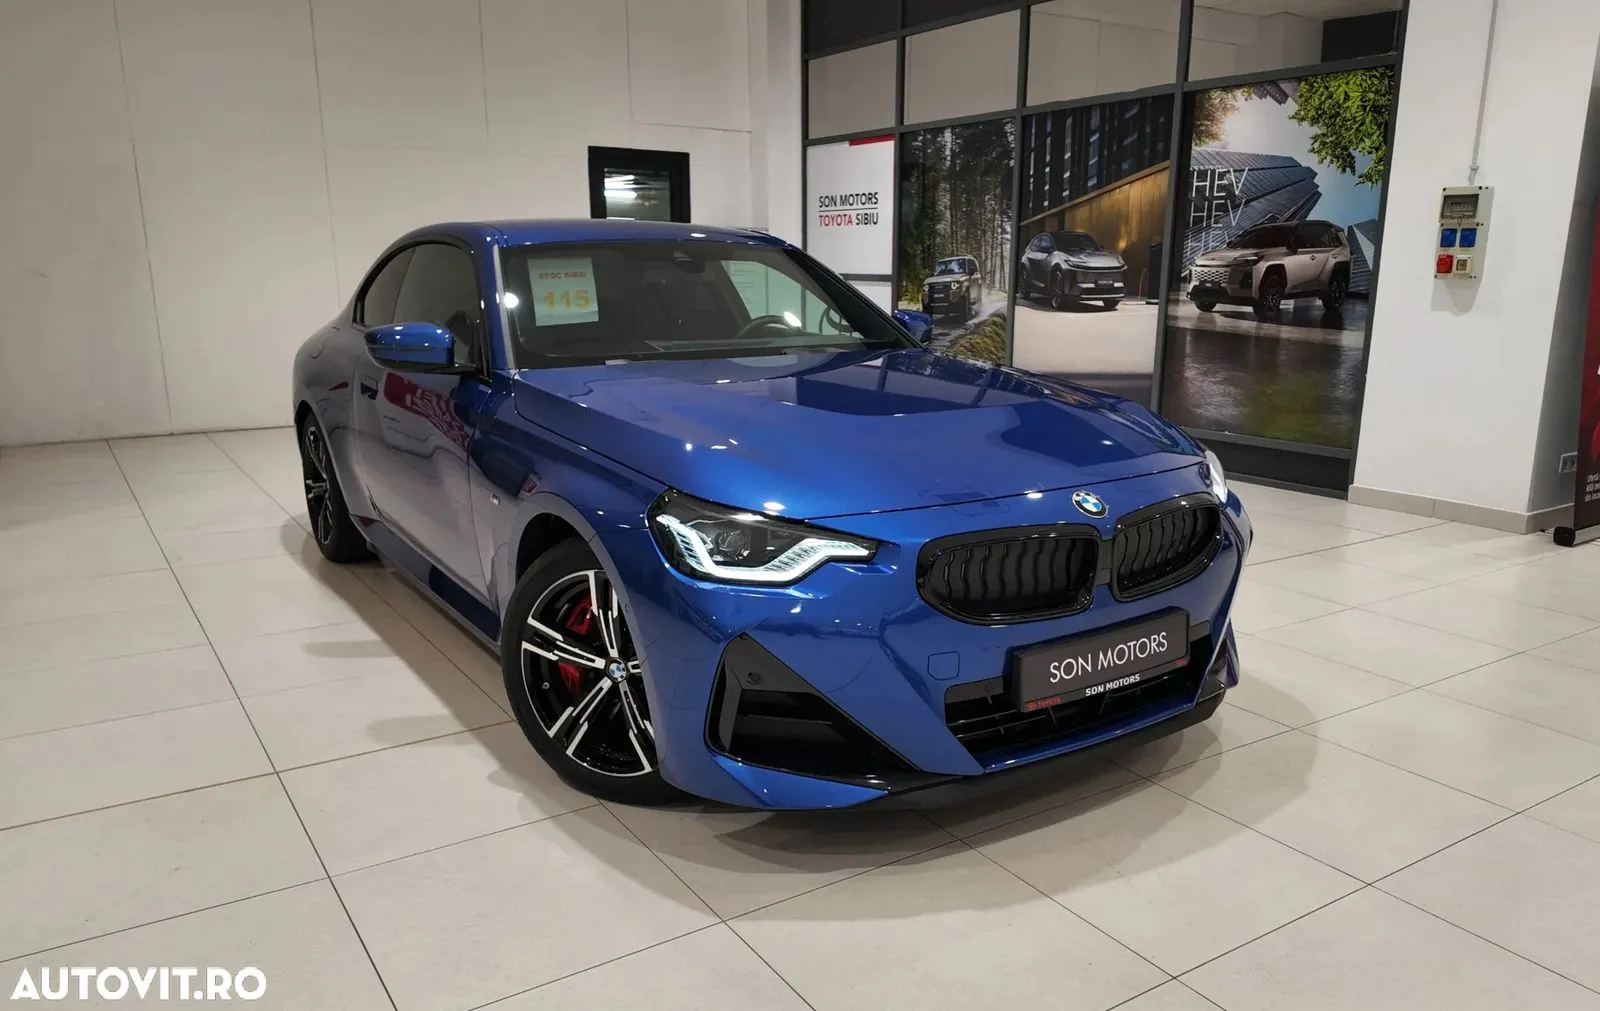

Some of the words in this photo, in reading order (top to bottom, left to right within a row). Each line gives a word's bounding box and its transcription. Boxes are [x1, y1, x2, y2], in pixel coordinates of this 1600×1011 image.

[1192, 167, 1248, 197] HEV
[818, 195, 837, 208] SON
[839, 192, 878, 206] MOTORS
[818, 214, 853, 227] TOYOTA
[855, 212, 878, 225] SIBIU
[1190, 198, 1246, 227] HEV
[544, 289, 590, 310] 115
[1050, 653, 1092, 683] SON
[1097, 631, 1168, 672] MOTORS
[1085, 684, 1105, 697] SON
[1105, 673, 1141, 692] MOTORS
